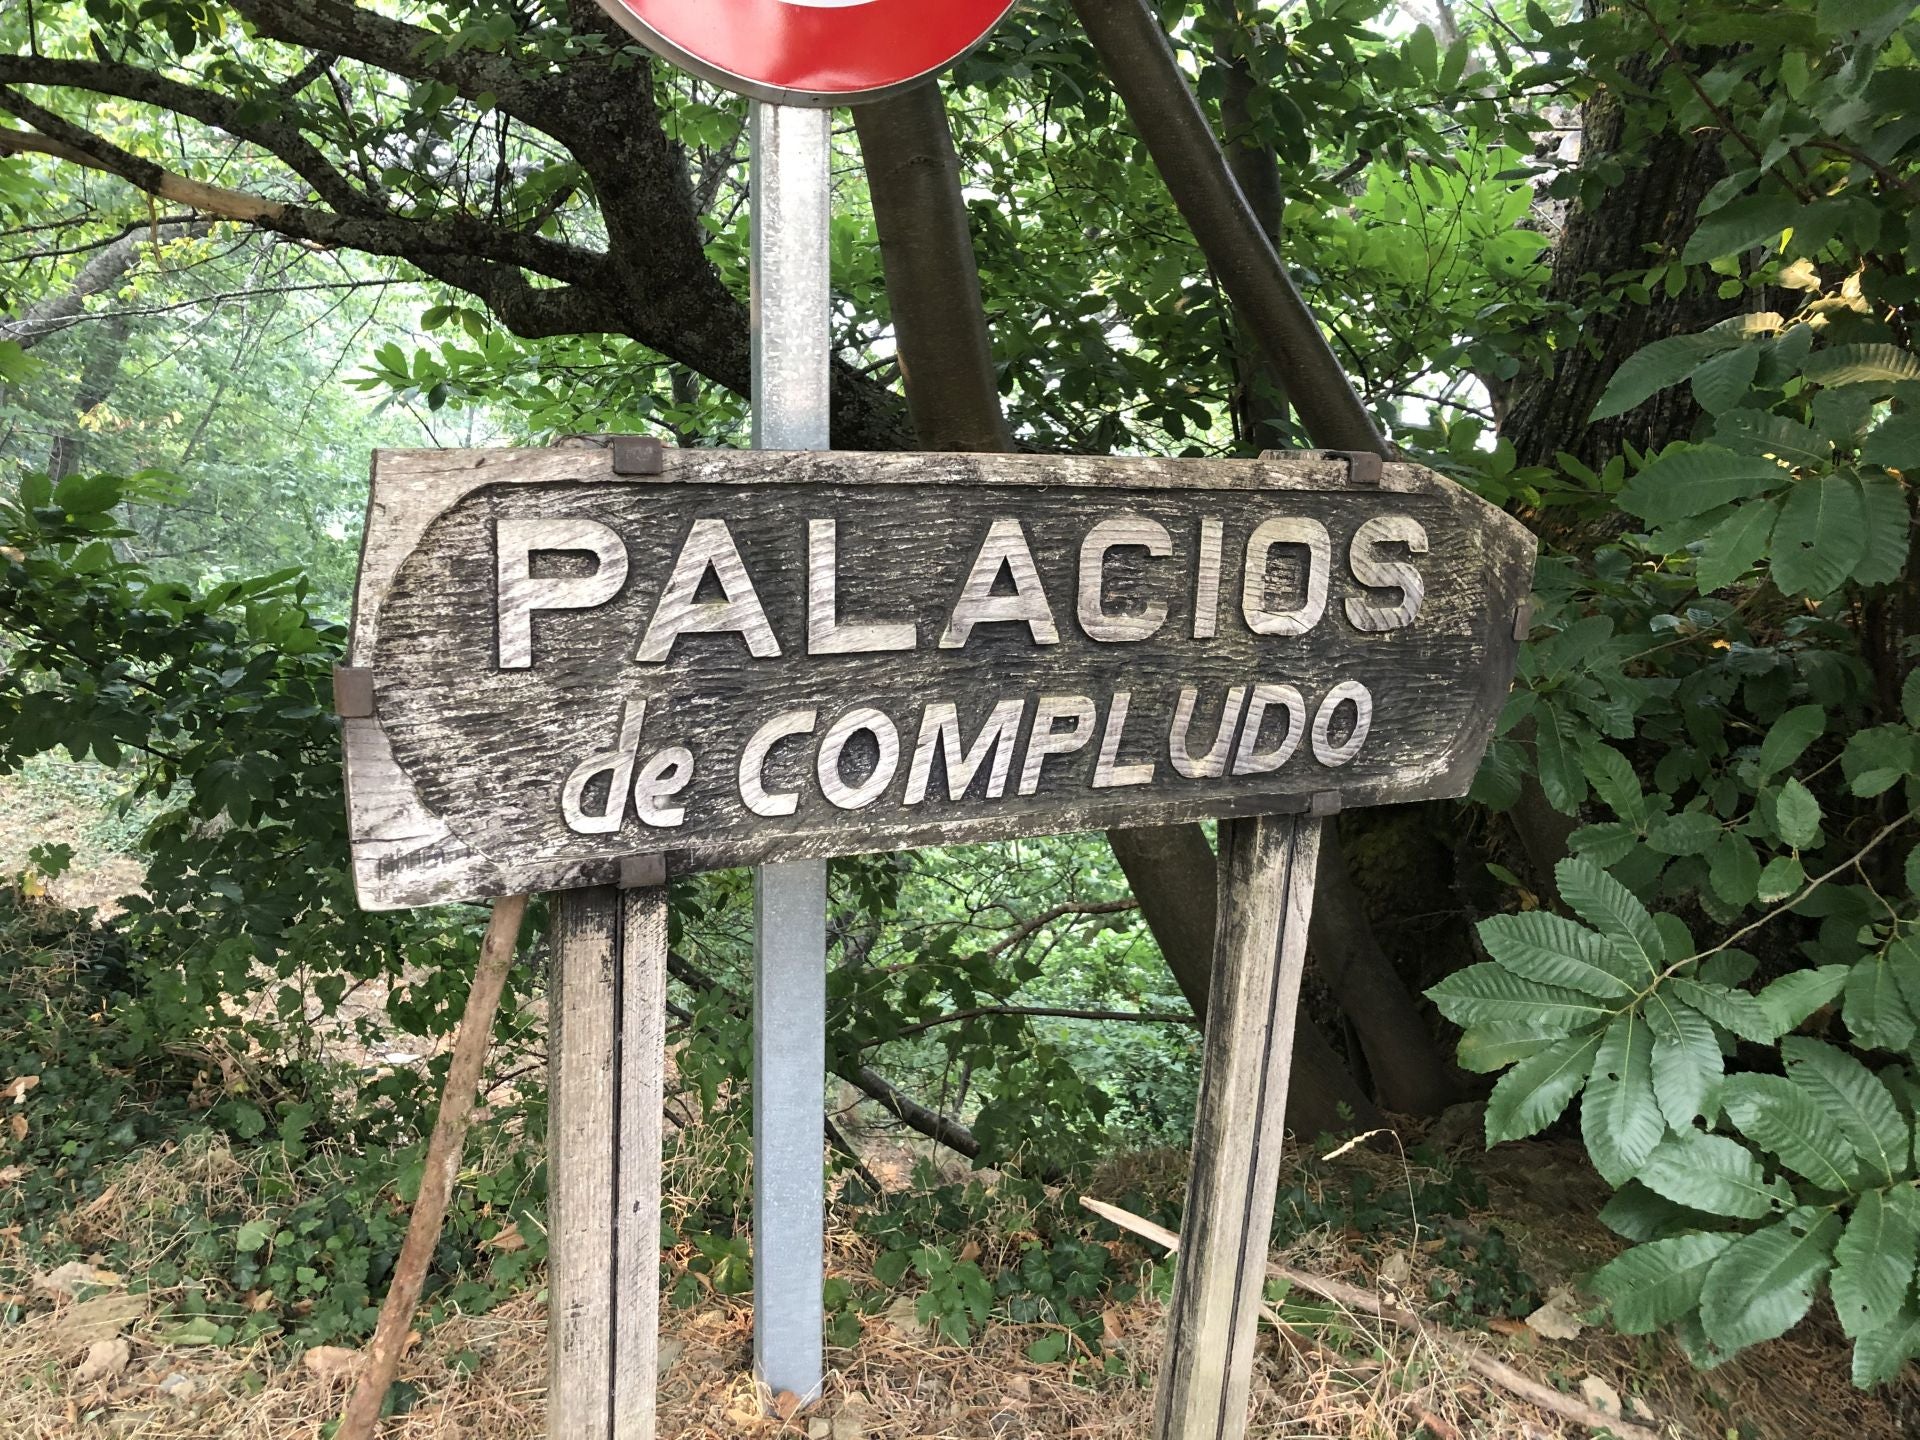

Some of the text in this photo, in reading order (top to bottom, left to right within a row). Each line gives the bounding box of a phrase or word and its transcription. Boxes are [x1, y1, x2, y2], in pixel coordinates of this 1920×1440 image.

[497, 516, 1429, 669] PALACIOS
[562, 680, 1373, 835] de COMPLUDO
